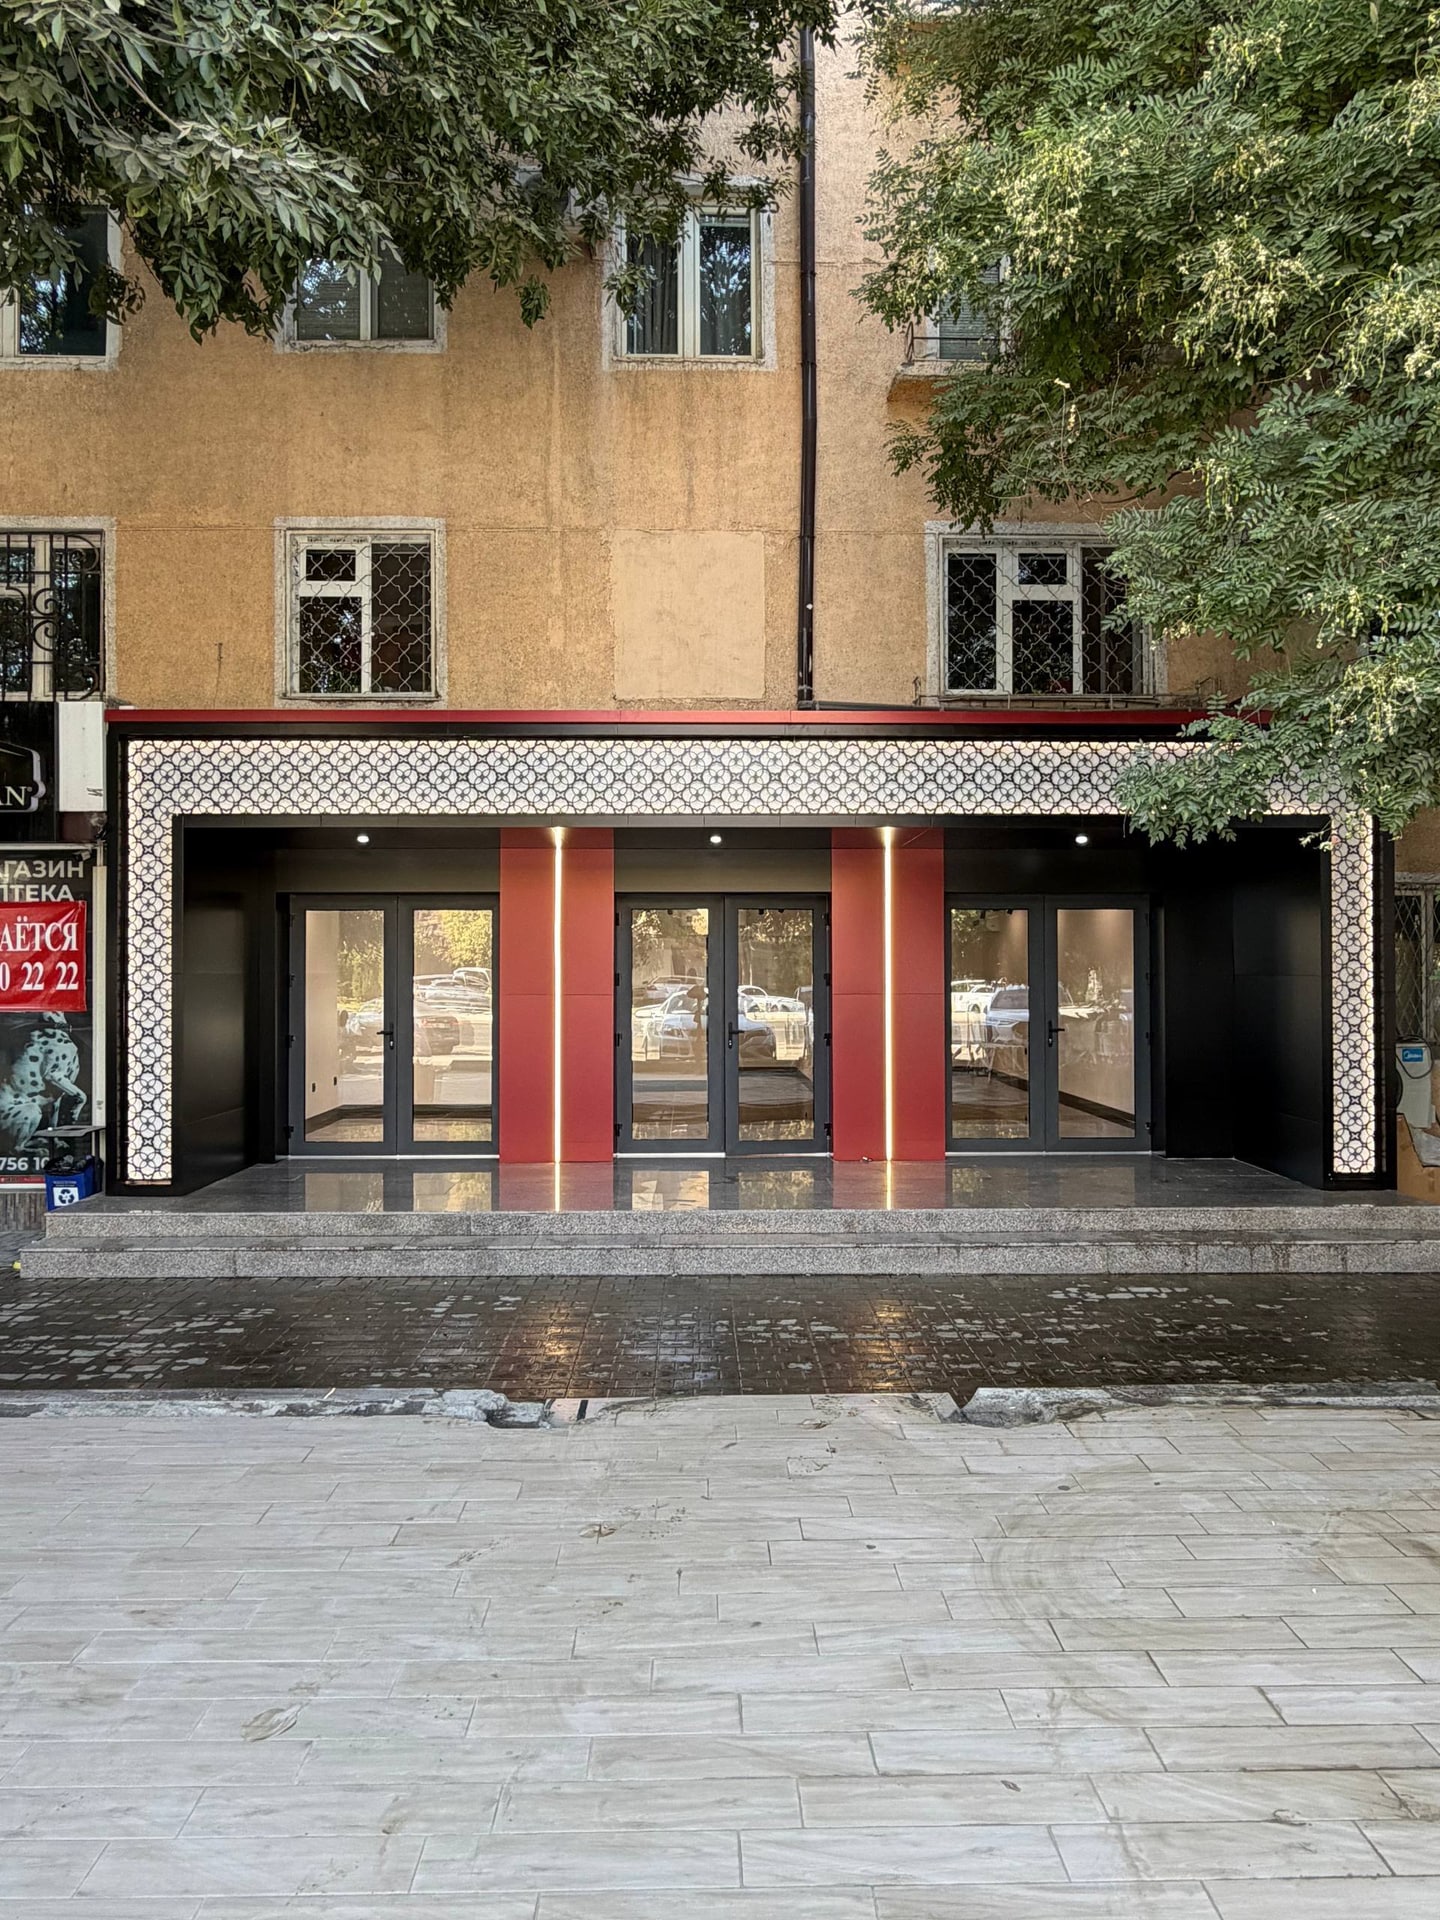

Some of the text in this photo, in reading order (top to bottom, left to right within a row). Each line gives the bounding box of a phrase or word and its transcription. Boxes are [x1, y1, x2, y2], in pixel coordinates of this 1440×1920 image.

[0, 785, 27, 806] N
[0, 860, 84, 878] ГАЗИН
[0, 915, 79, 952] АЁТСЯ
[21, 961, 45, 991] 22
[55, 961, 79, 991] 22
[0, 1157, 29, 1171] 756
